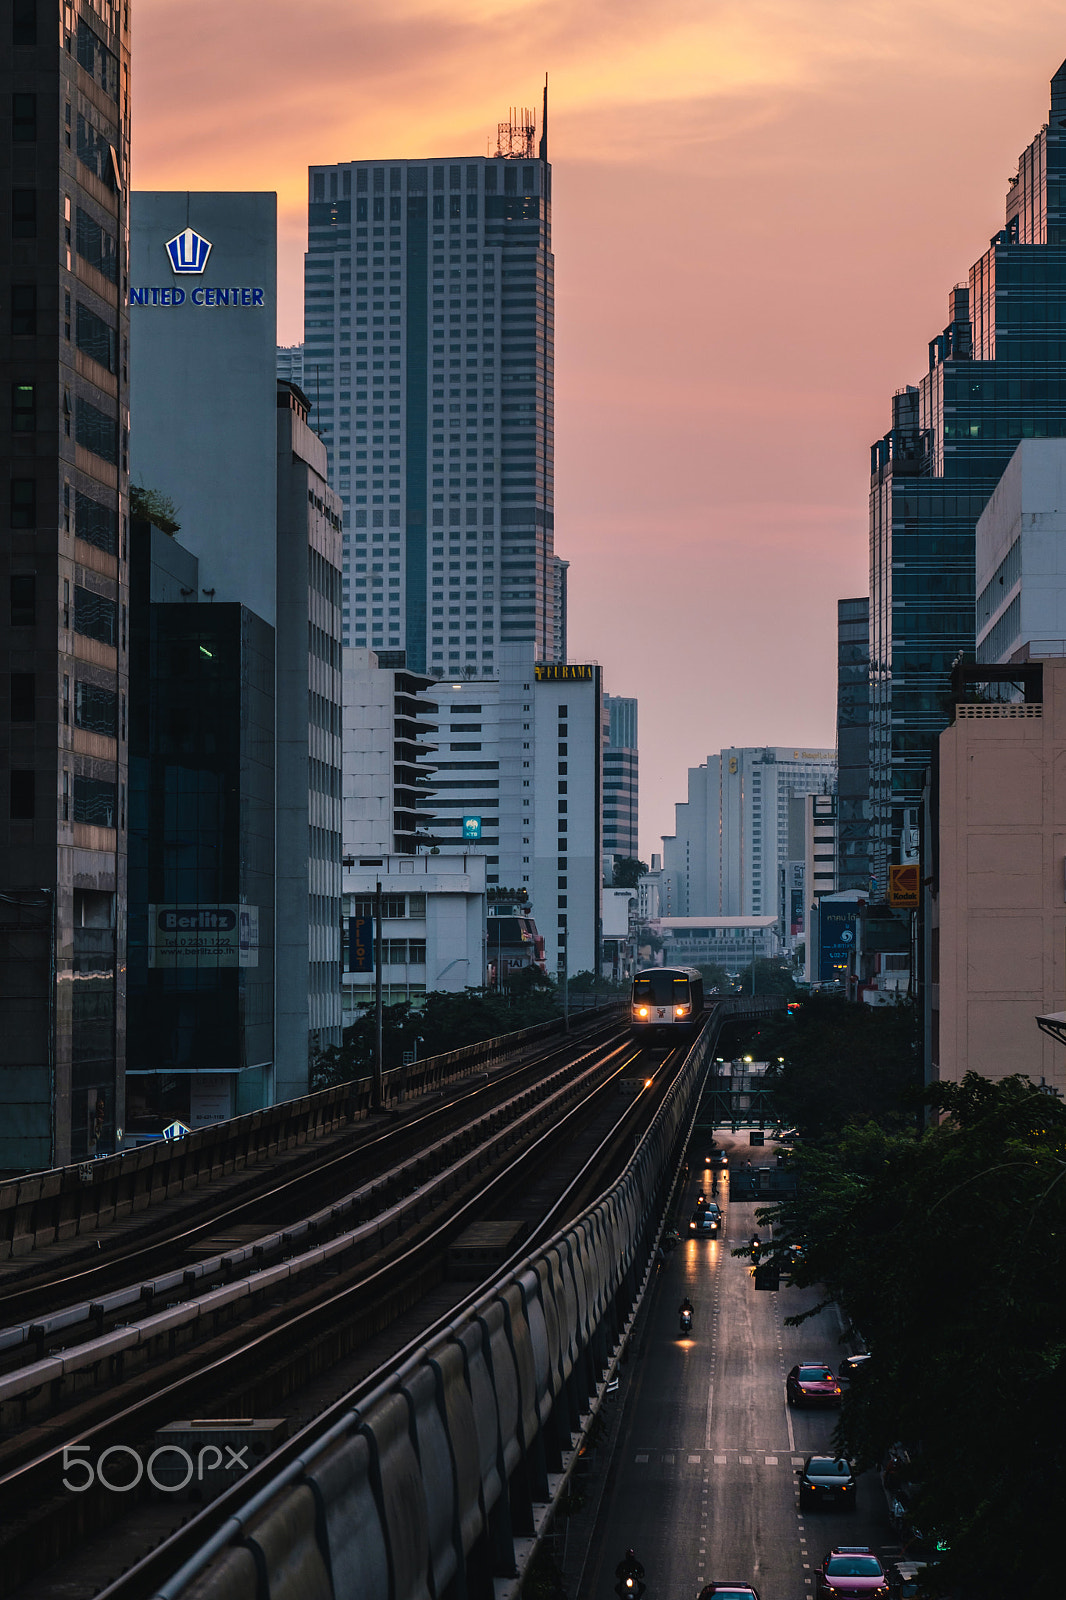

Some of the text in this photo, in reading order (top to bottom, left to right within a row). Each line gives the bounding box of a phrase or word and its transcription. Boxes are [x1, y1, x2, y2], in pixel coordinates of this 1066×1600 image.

[129, 287, 265, 306] NITED CENTER
[547, 666, 593, 679] FURAMA
[893, 892, 917, 900] Kodak
[165, 911, 230, 928] Berlitz
[355, 919, 366, 967] PILOT
